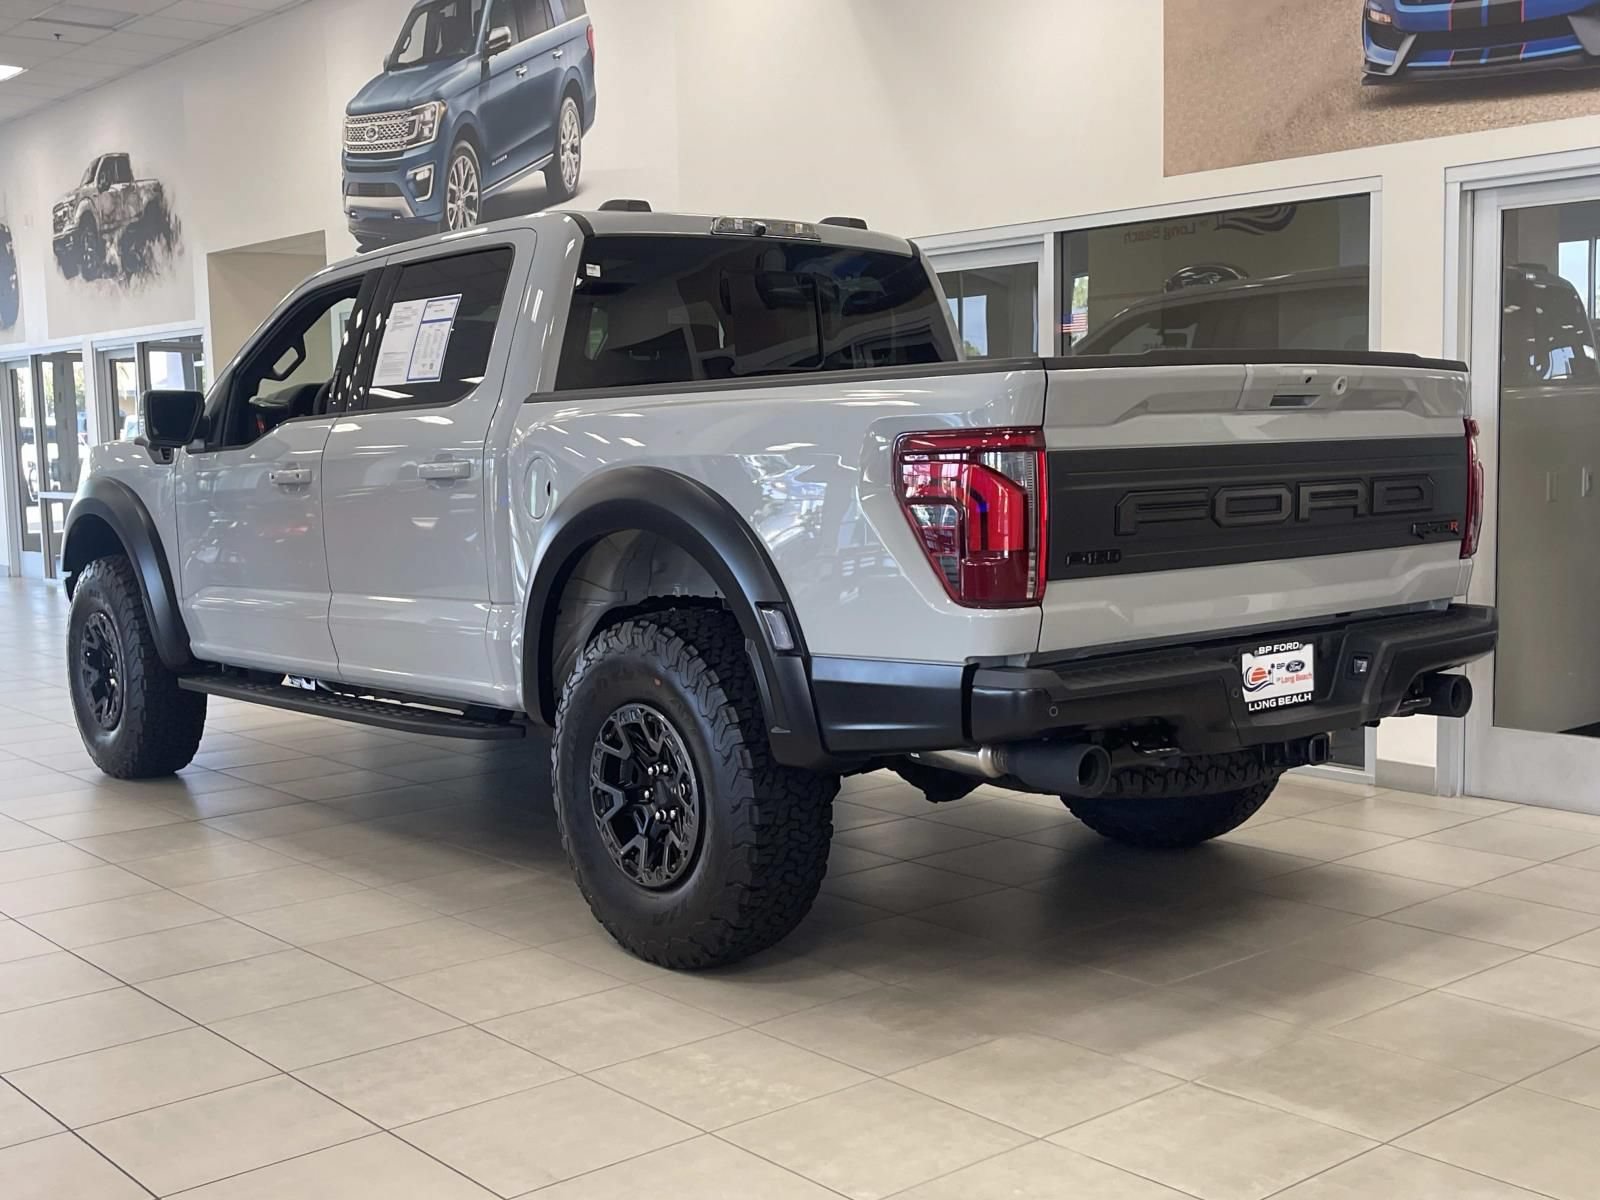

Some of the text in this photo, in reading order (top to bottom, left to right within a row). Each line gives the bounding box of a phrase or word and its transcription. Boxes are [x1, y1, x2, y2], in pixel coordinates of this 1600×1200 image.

[1114, 473, 1434, 536] FORD
[1258, 641, 1299, 655] BP FORD
[1248, 692, 1312, 712] LONG BEACH
